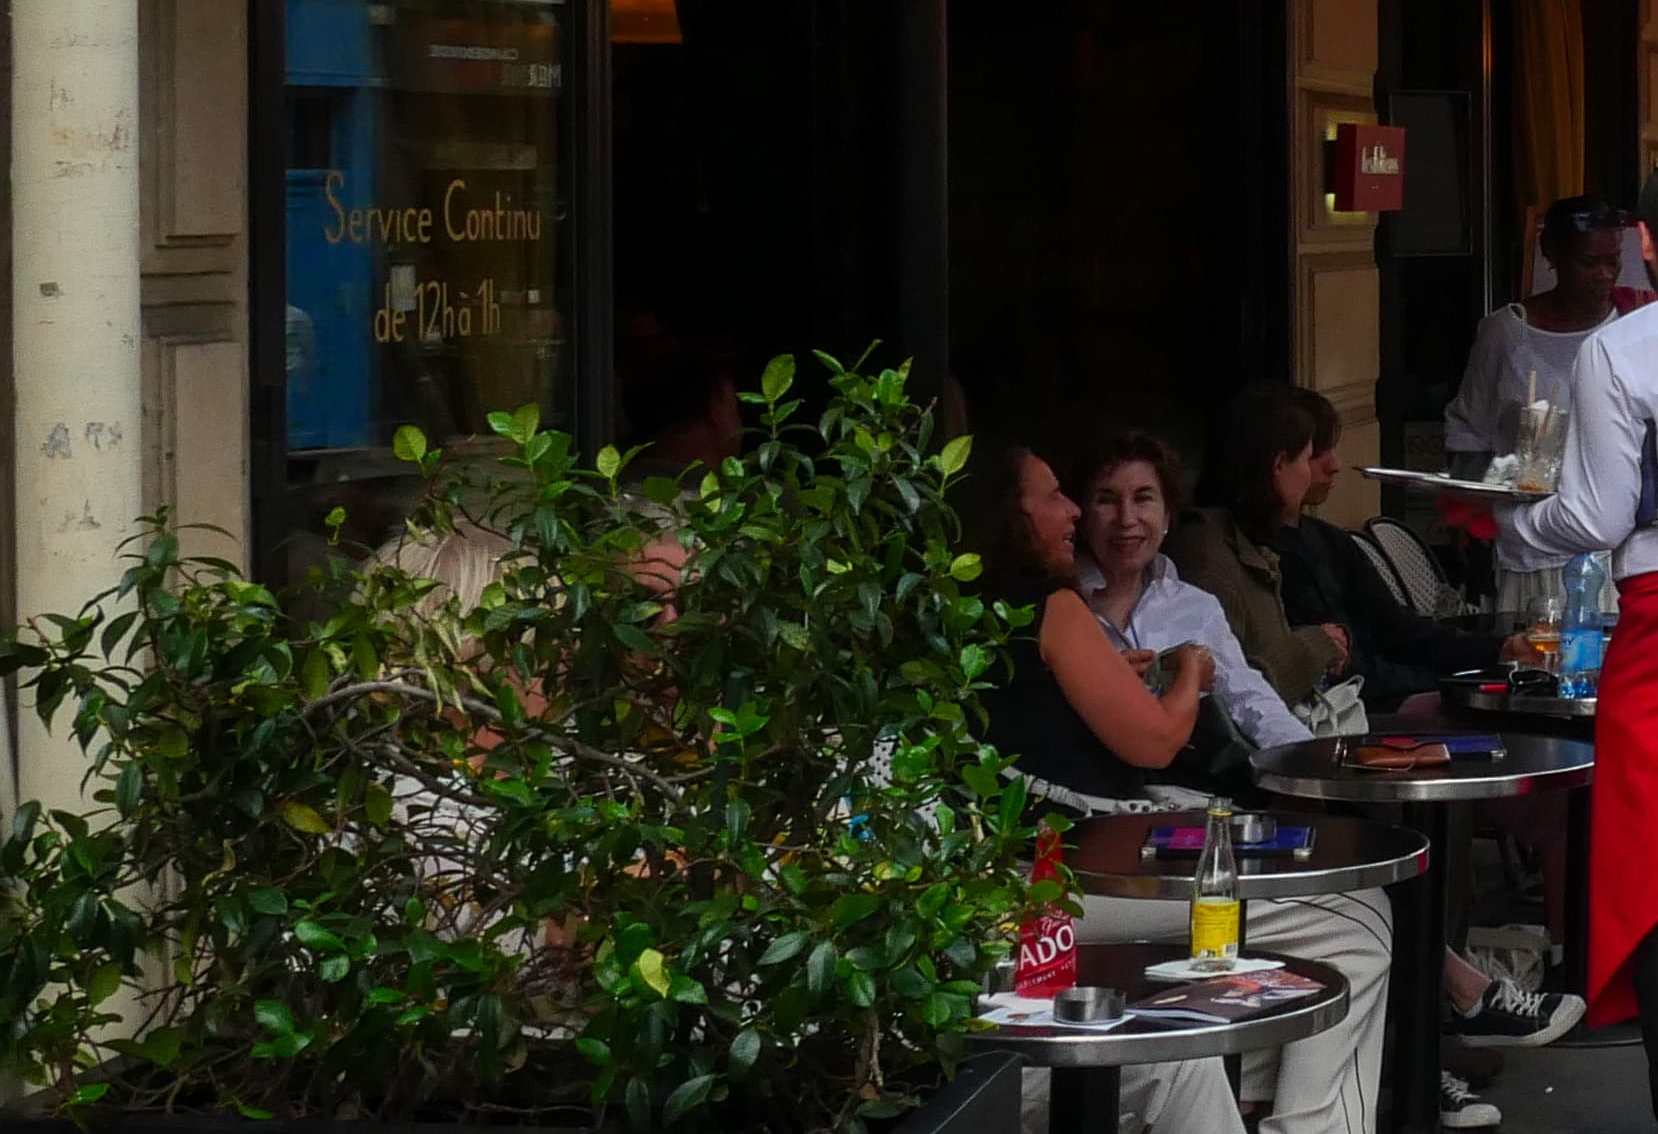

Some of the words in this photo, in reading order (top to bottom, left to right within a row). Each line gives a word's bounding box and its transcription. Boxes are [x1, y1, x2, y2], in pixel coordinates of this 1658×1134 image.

[325, 171, 432, 243] Service
[445, 179, 541, 242] Continu
[374, 282, 407, 343] de
